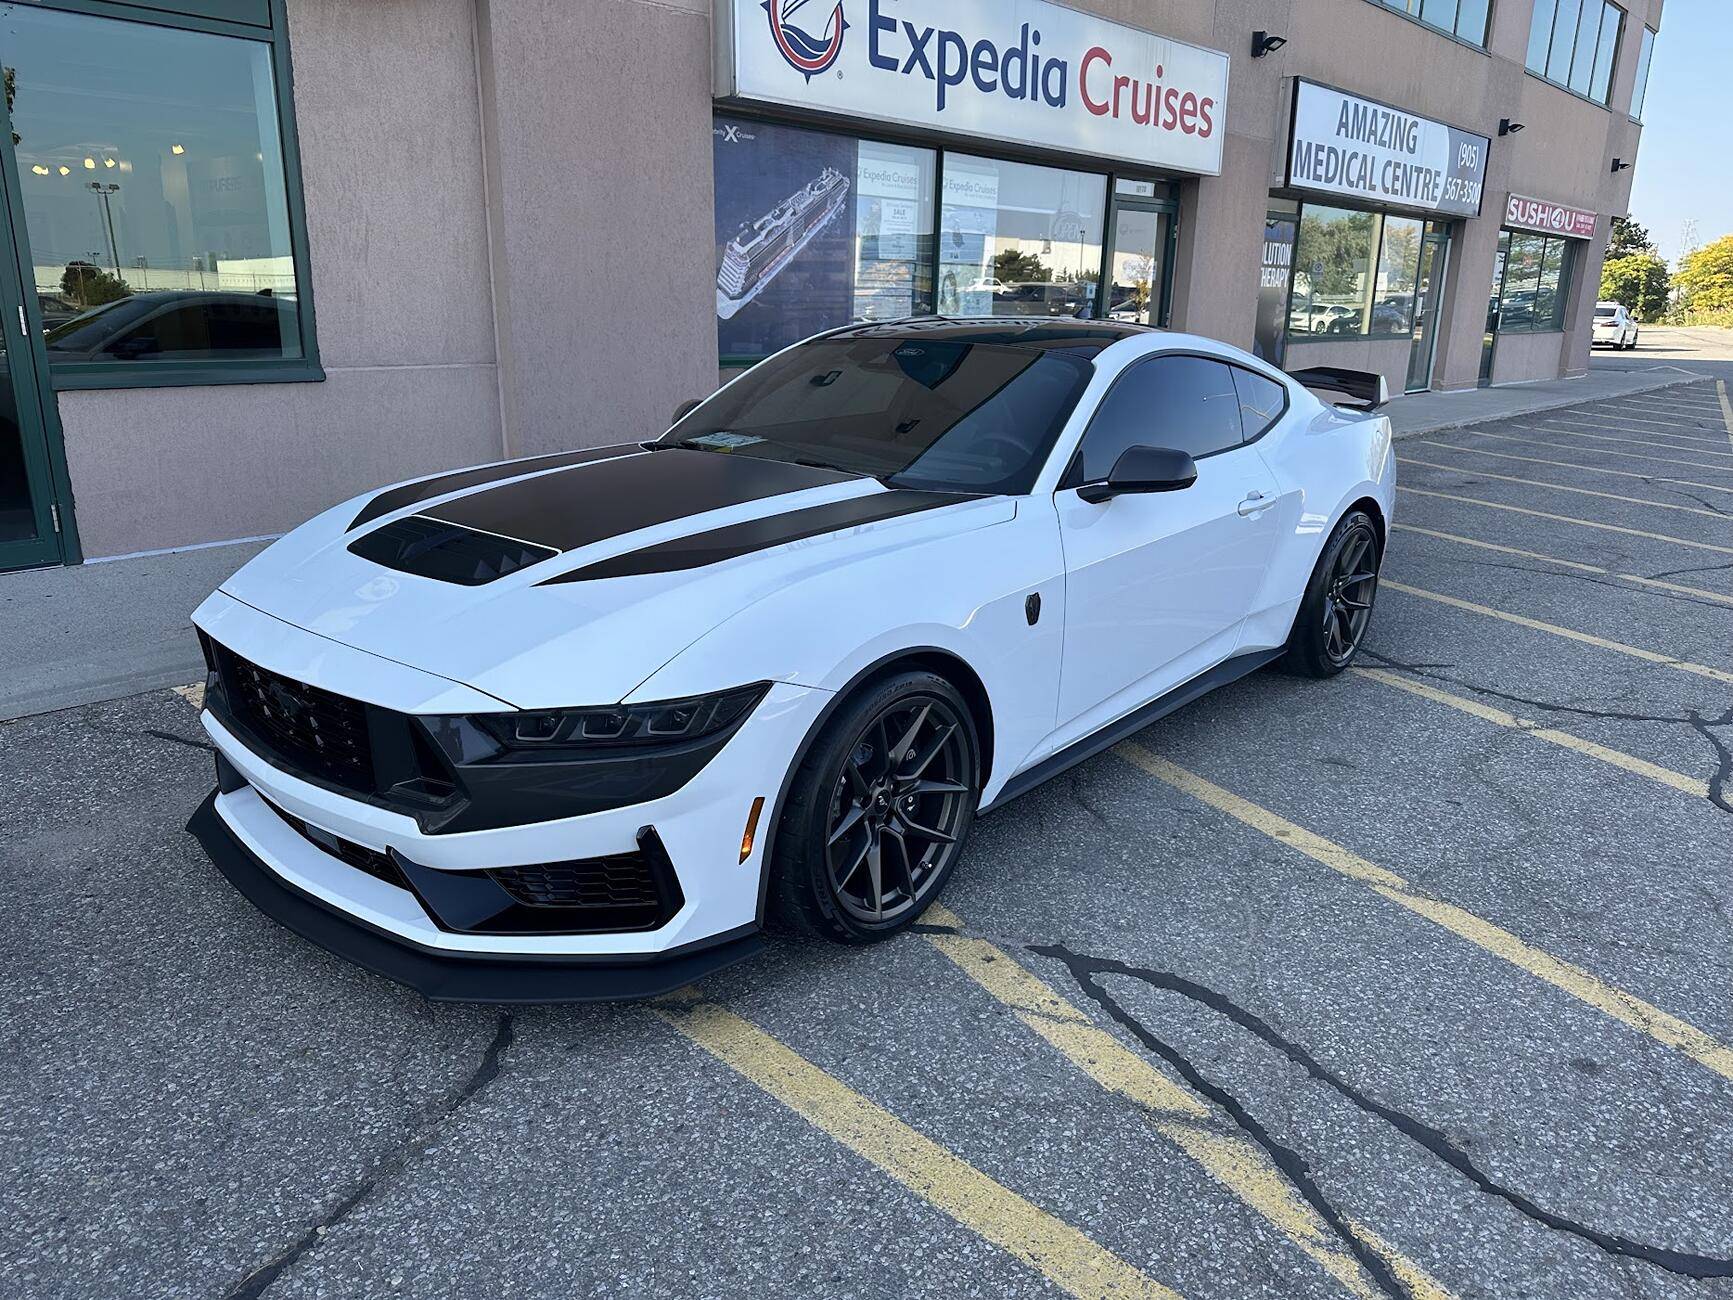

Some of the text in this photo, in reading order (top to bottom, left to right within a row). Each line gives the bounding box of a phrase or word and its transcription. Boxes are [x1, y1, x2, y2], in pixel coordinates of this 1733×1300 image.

[869, 0, 1213, 138] Expedia Cruises
[1336, 99, 1418, 154] AMAZING
[1293, 139, 1441, 202] MEDICAL CENTRE
[1457, 142, 1479, 172] (905)
[863, 168, 891, 183] Expedia
[1262, 242, 1292, 266] LUTION
[1261, 267, 1290, 288] THERAPY
